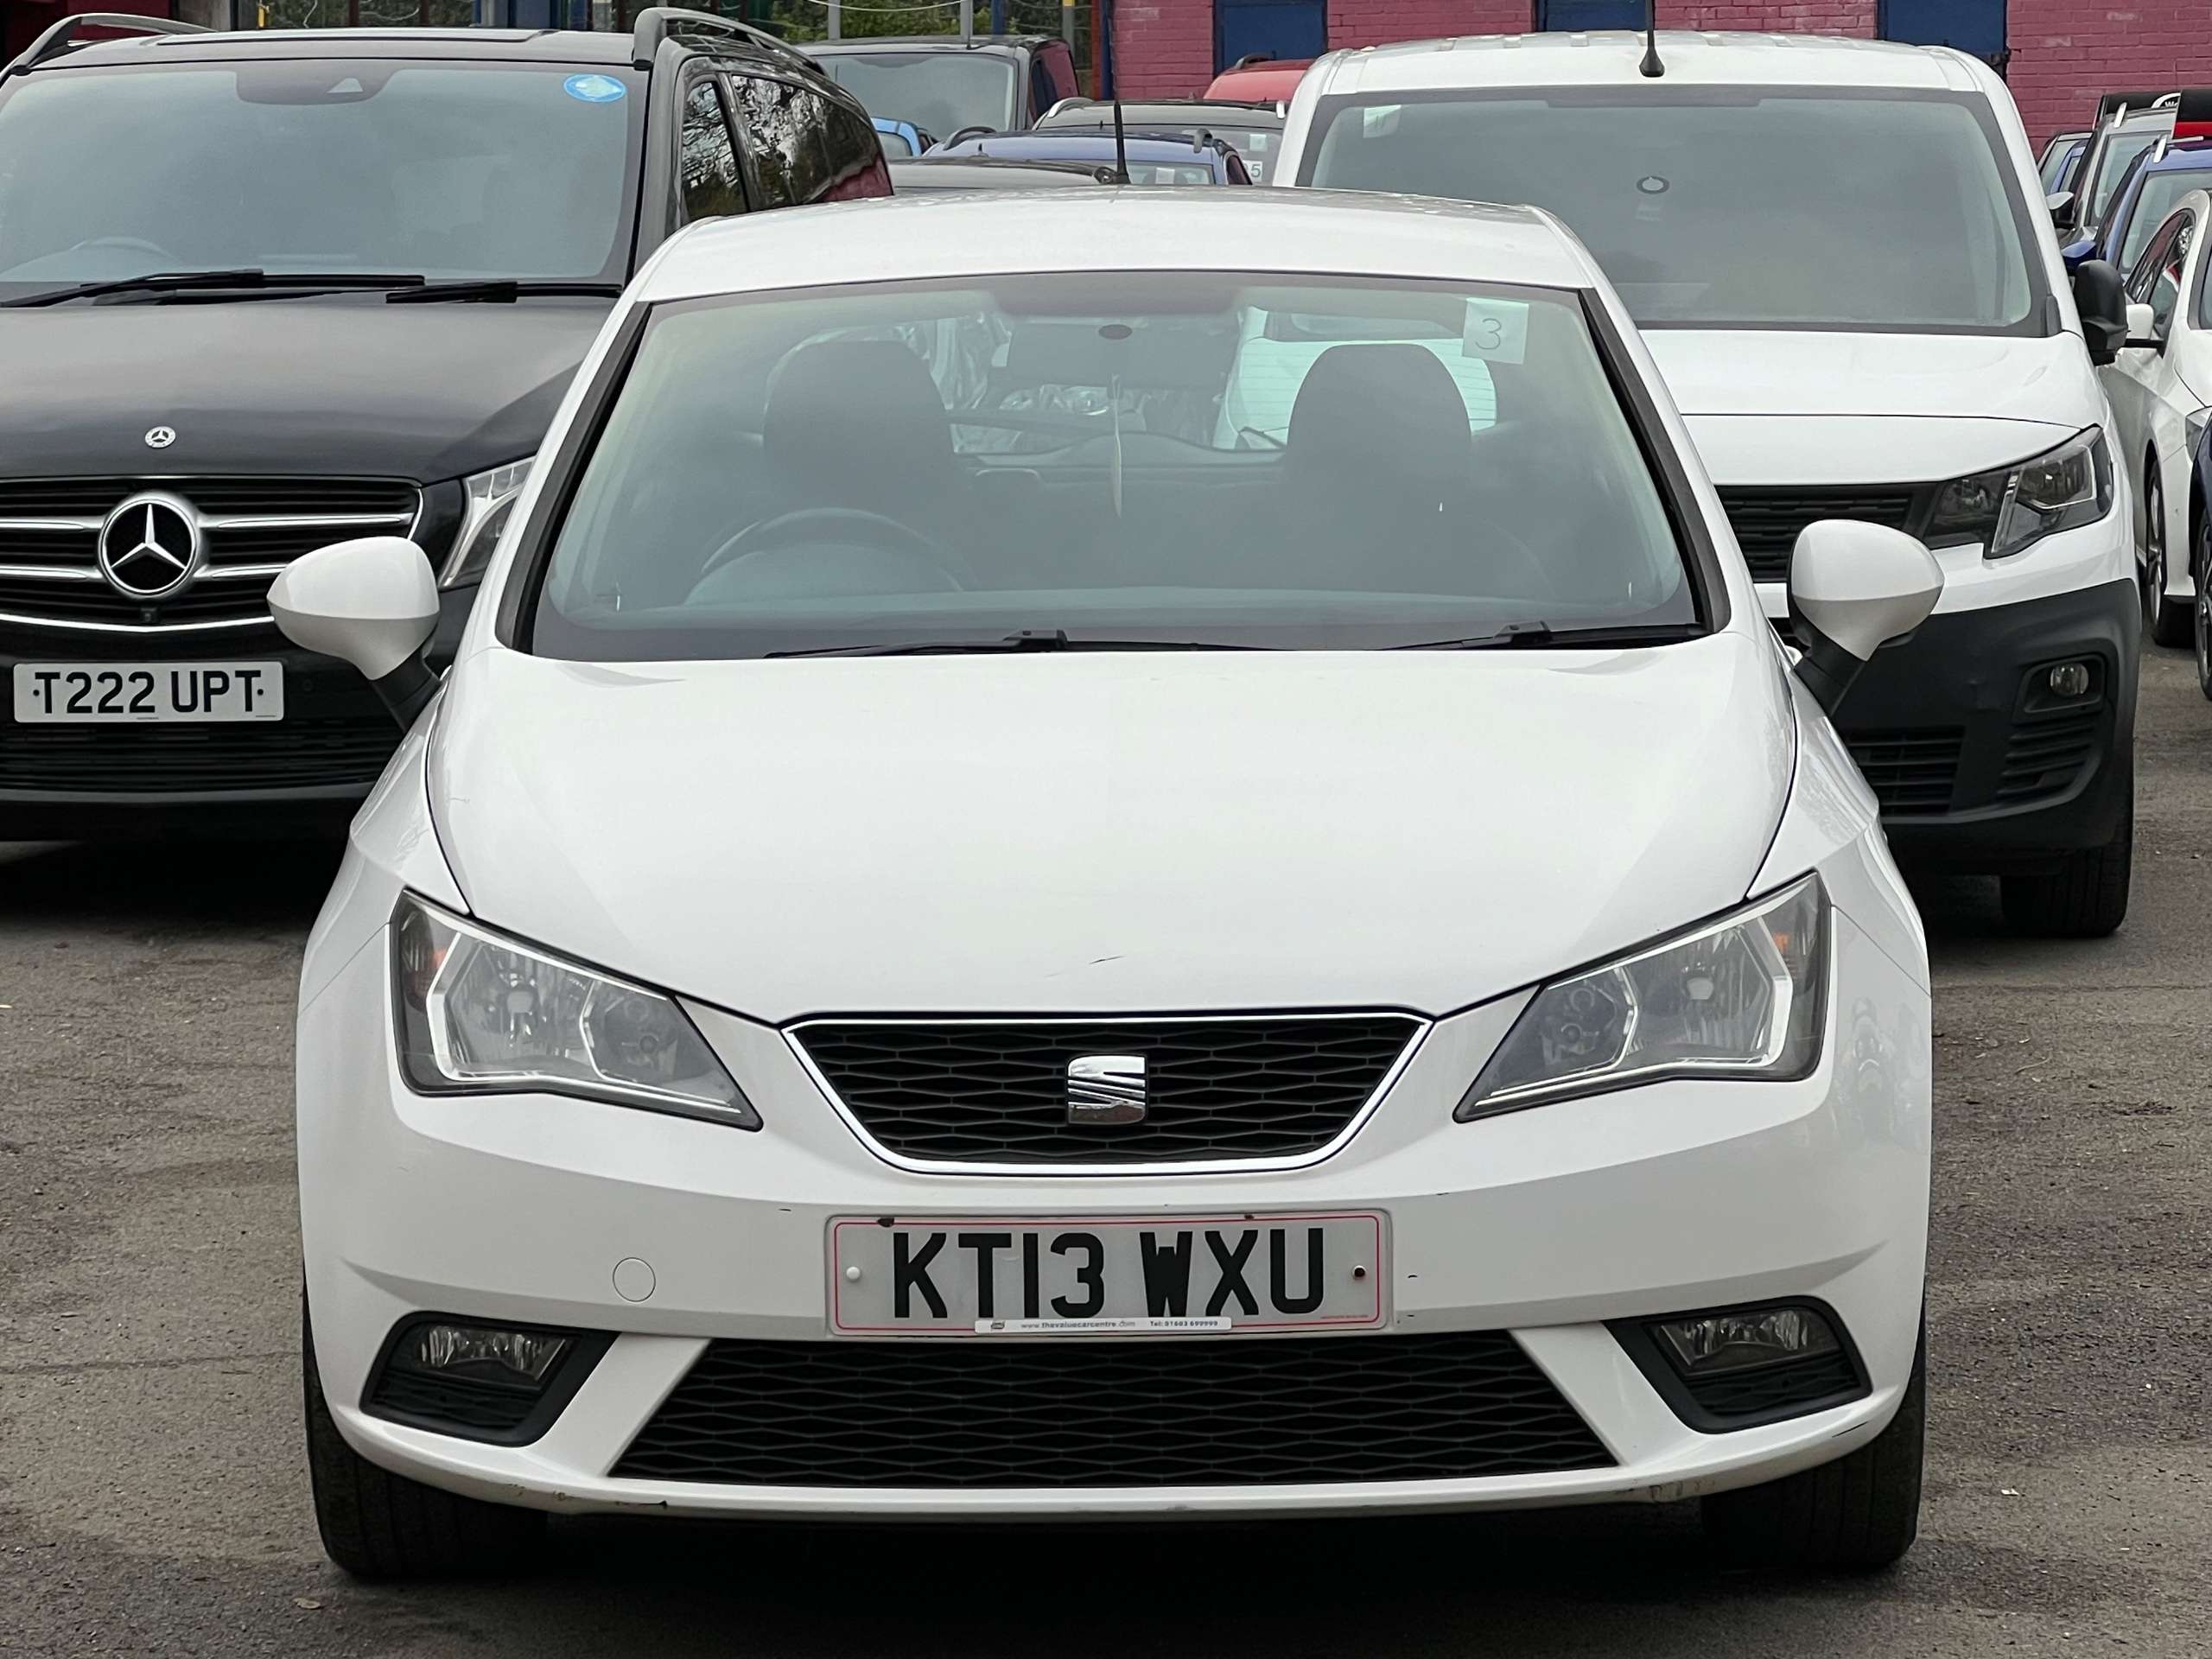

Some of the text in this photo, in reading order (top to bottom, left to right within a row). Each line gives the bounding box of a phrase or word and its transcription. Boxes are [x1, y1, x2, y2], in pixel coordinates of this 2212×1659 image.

[1475, 317, 1502, 350] 3
[35, 670, 262, 714] T222 UPT
[893, 1227, 1324, 1319] KT13 WXU
